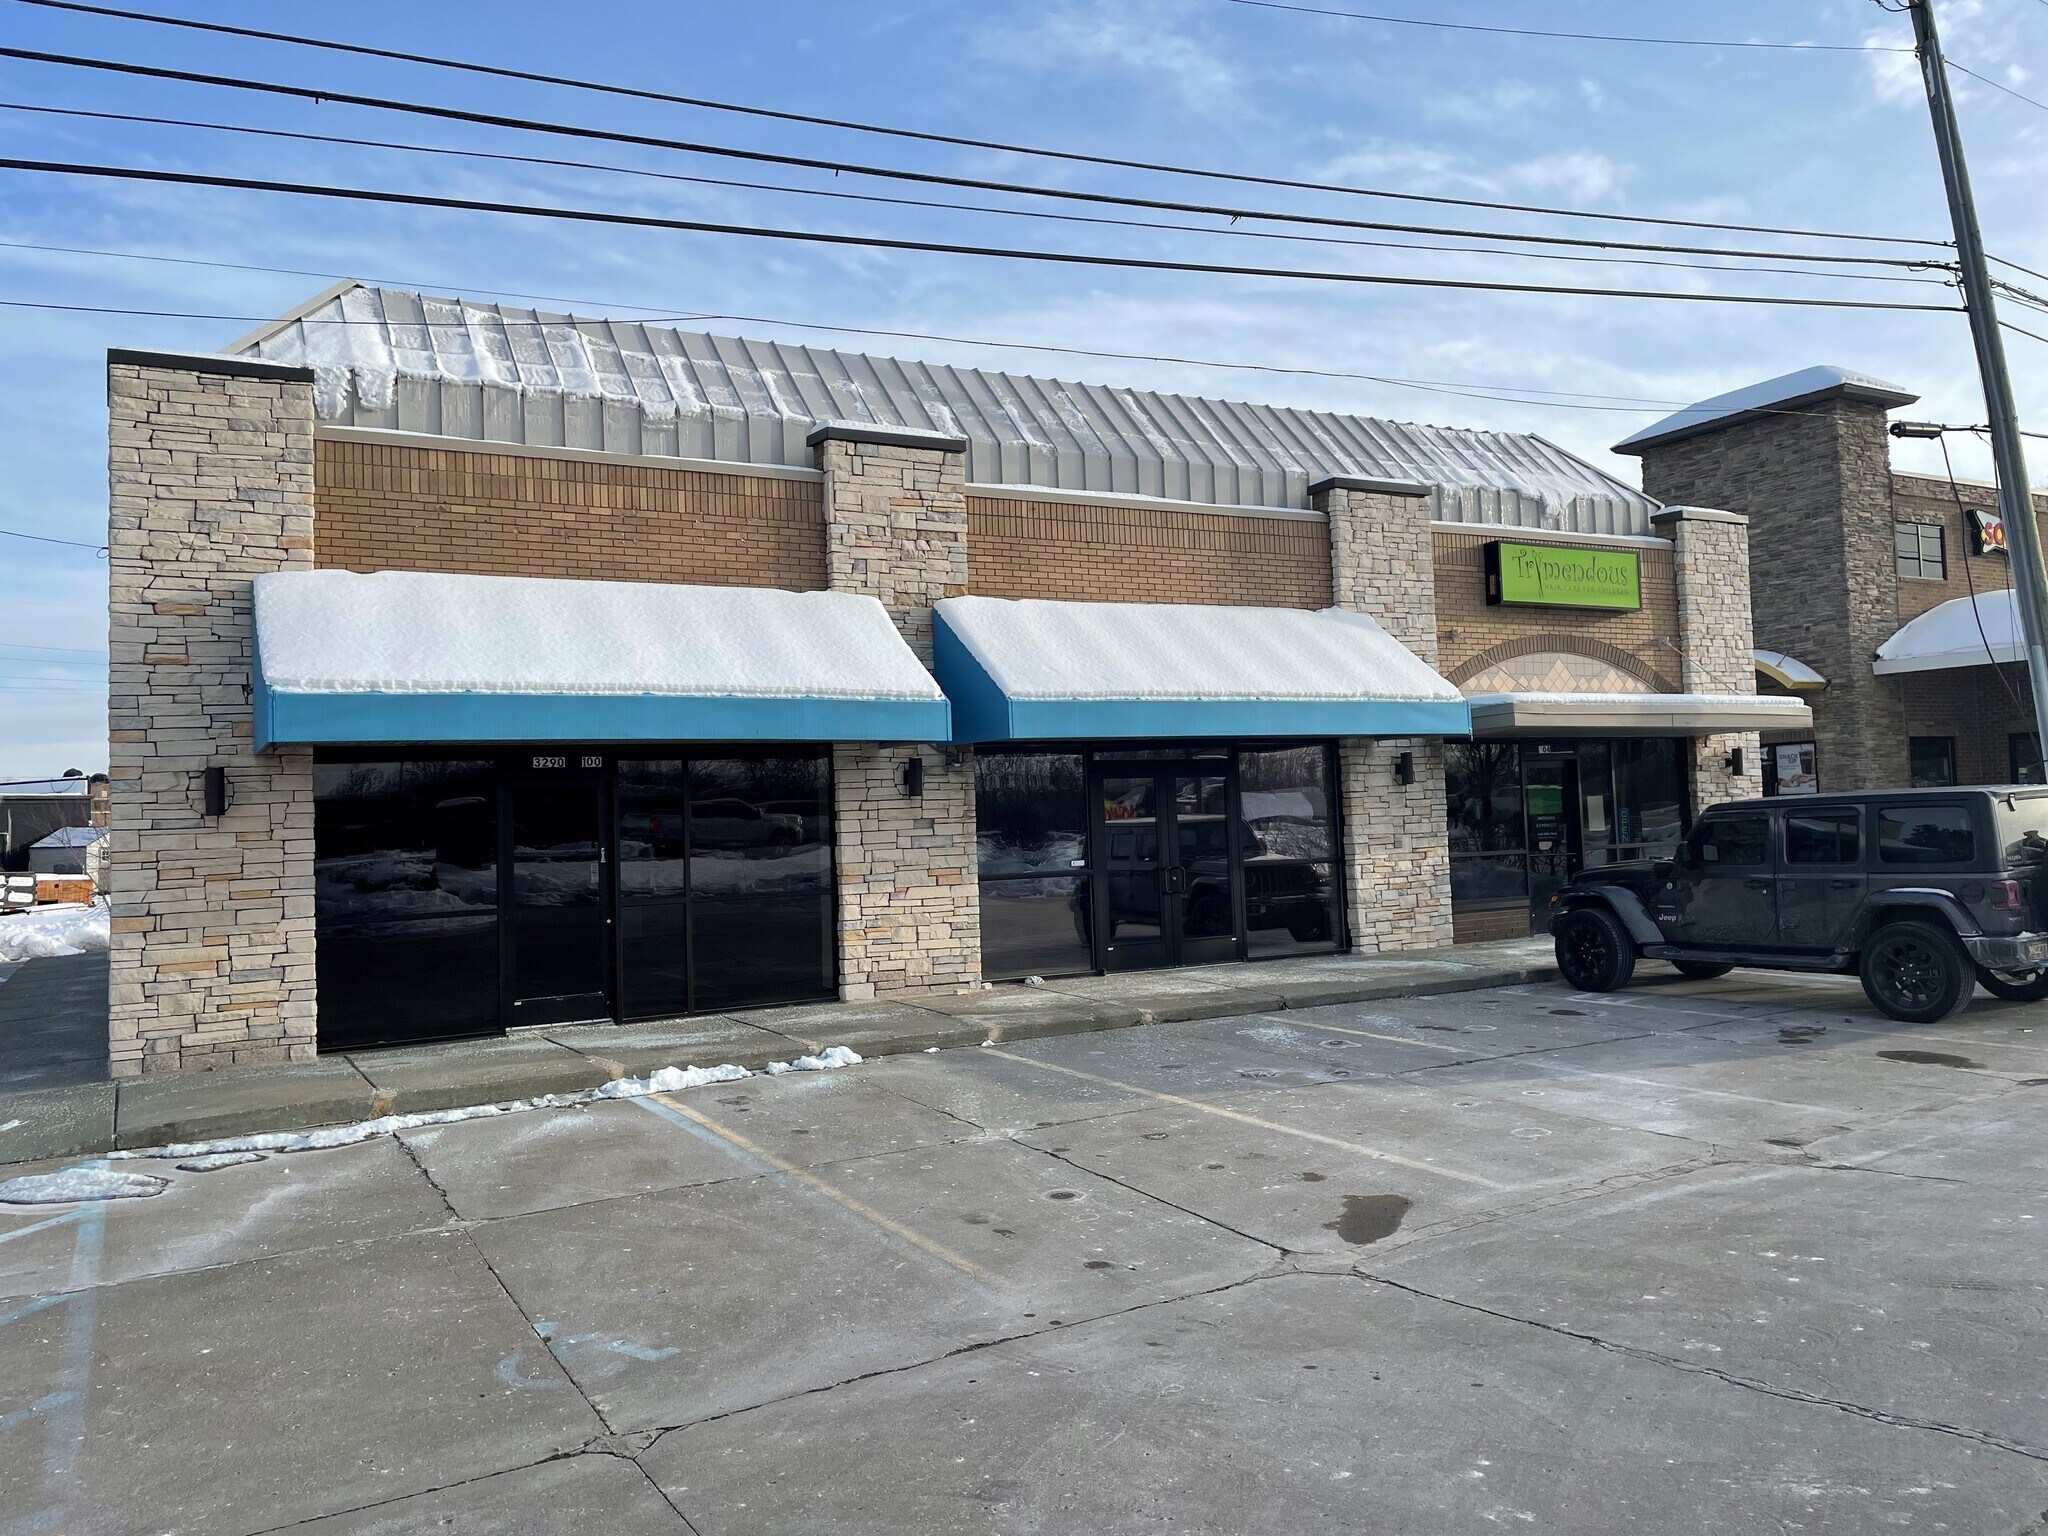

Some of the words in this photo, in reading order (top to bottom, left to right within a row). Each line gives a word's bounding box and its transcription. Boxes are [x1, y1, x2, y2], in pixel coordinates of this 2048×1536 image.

[1544, 583, 1562, 591] HAIR
[533, 757, 566, 768] 3290
[582, 757, 602, 767] 100
[1621, 810, 1630, 842] OPEN
[1658, 913, 1676, 922] Jeep
